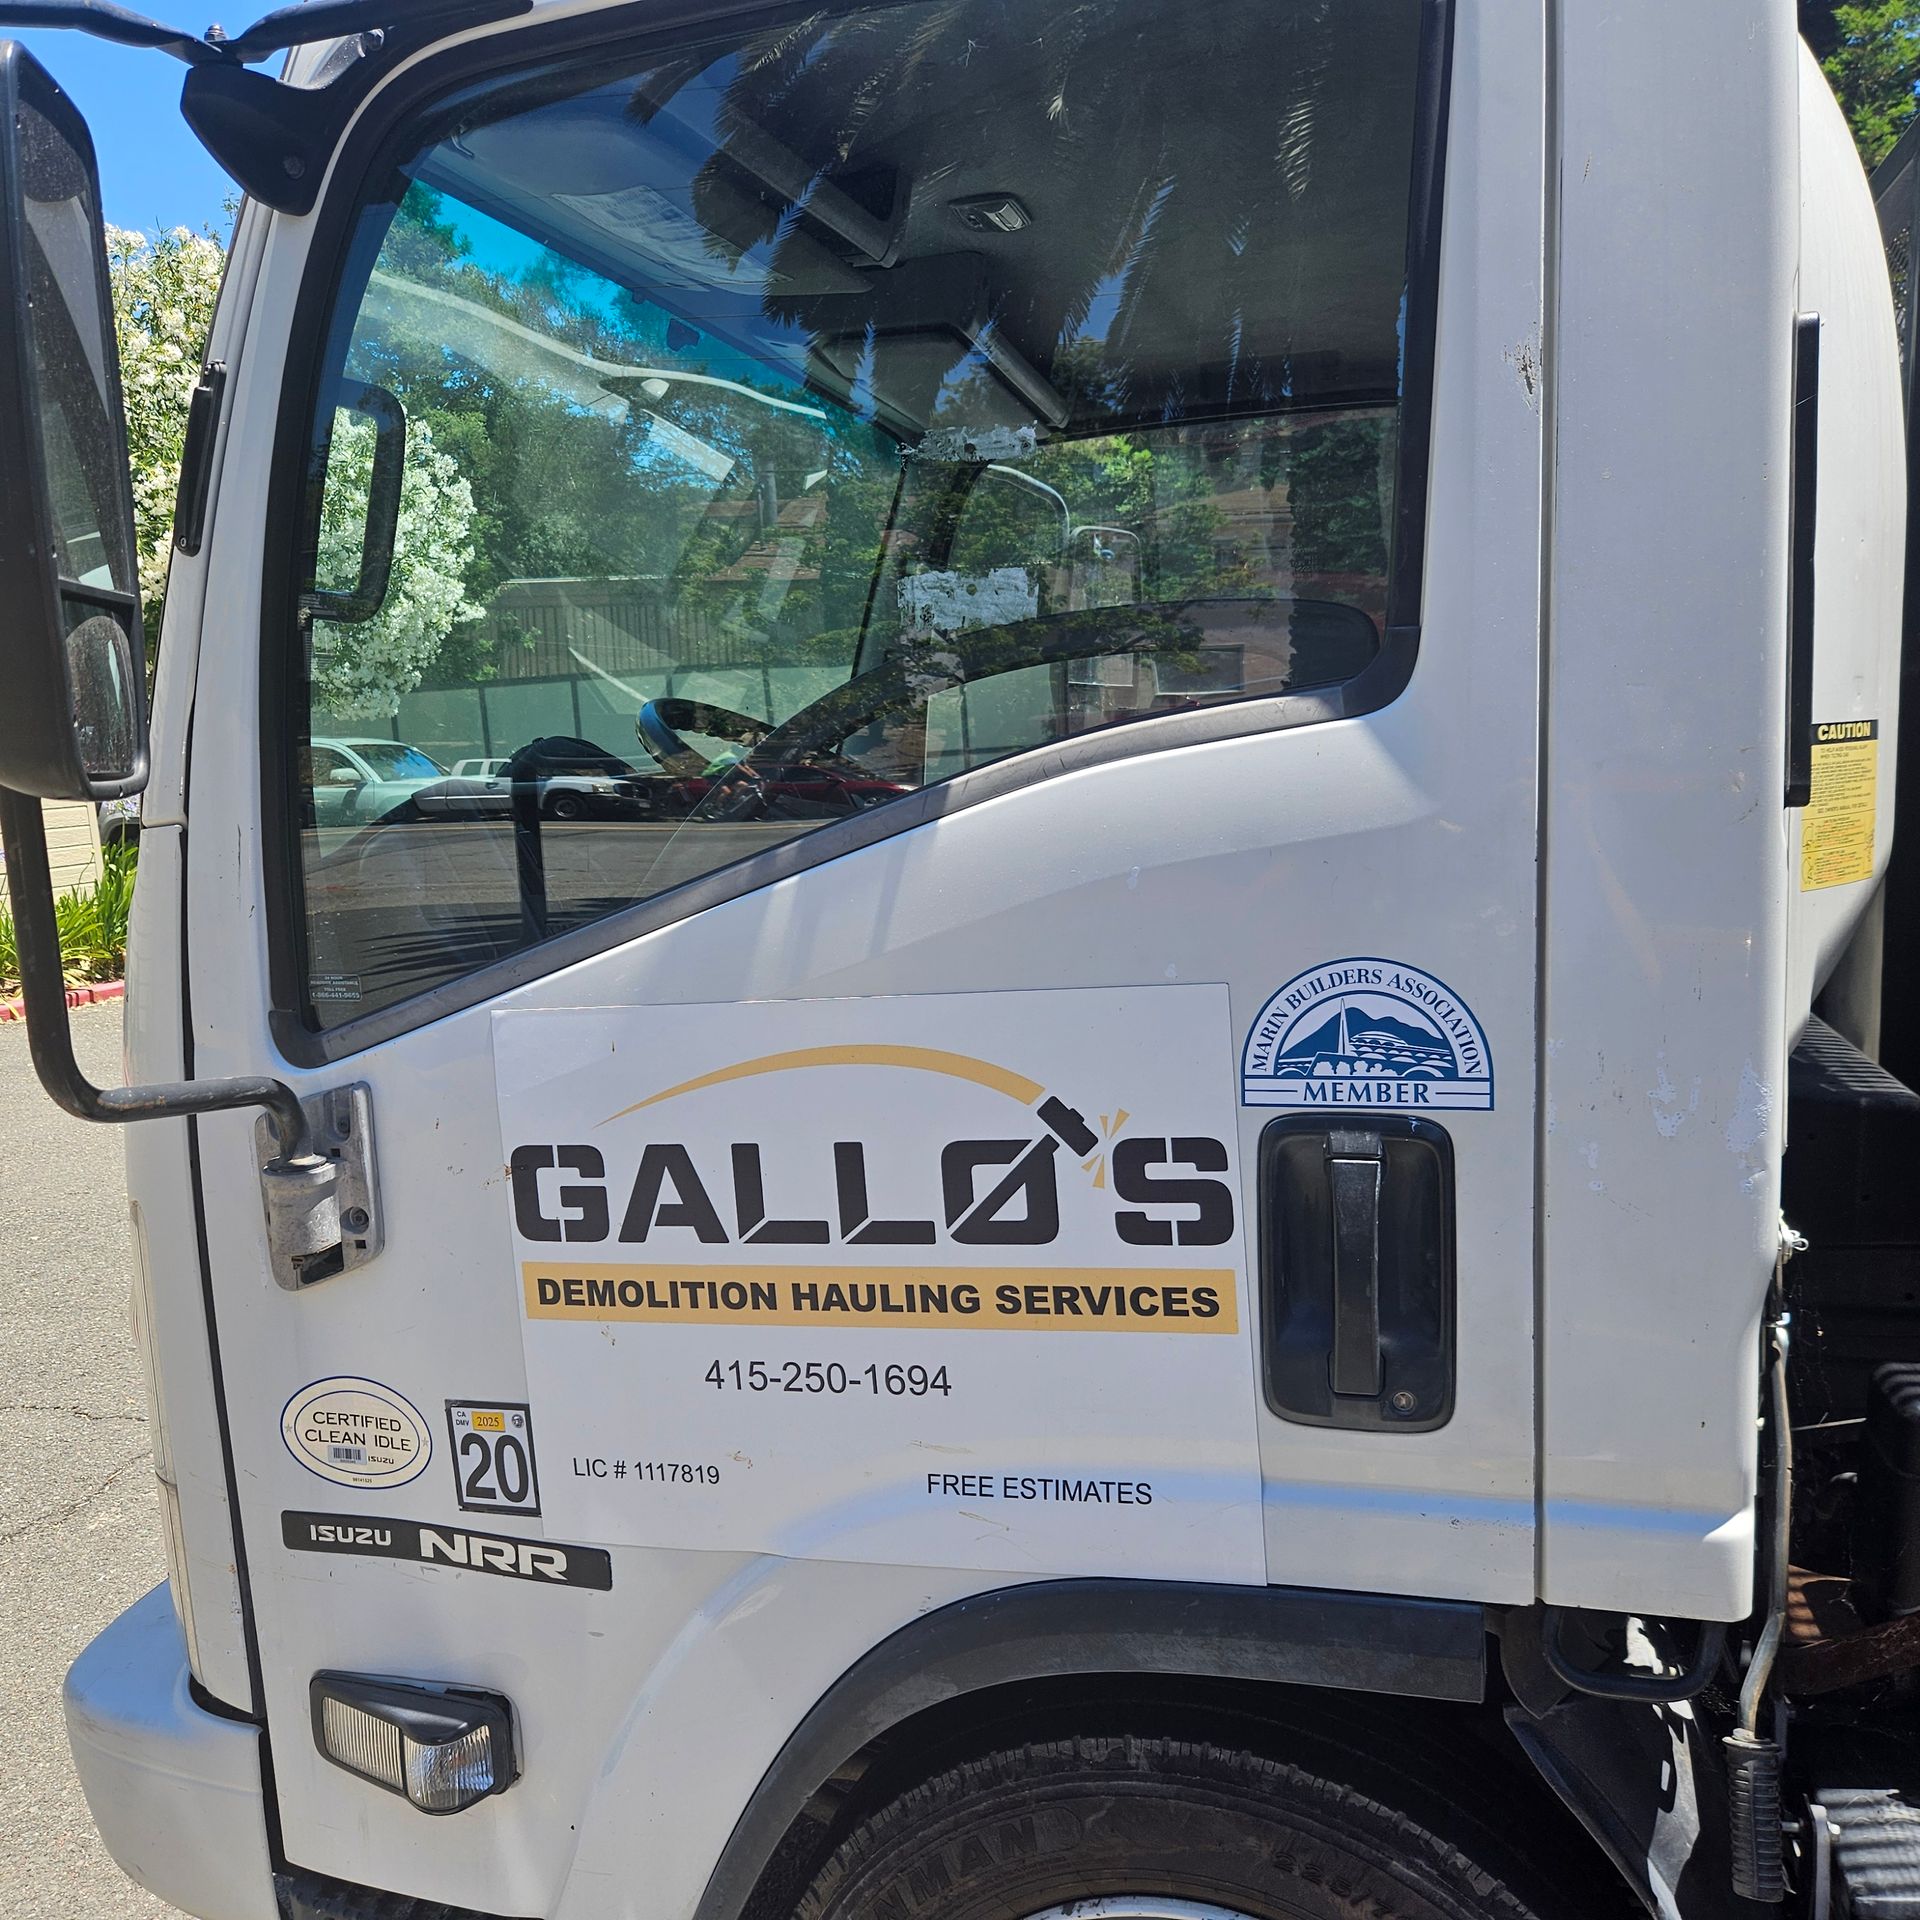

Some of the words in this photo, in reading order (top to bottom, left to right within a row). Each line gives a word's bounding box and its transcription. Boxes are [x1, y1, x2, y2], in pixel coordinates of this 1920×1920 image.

[1817, 721, 1871, 741] CAUTION
[1252, 1006, 1290, 1072] MARIN
[1285, 968, 1383, 1011] BUILDERS
[1387, 973, 1482, 1075] ASSOCIATION
[1303, 1082, 1429, 1104] MEMBER
[511, 1098, 1235, 1247] GALLO'S
[536, 1278, 778, 1311] DEMOLITION
[791, 1281, 981, 1315] HAULING
[995, 1285, 1221, 1319] SERVICES
[704, 1359, 952, 1397] 415-250-1694
[312, 1411, 402, 1433] CERTIFIED
[476, 1416, 500, 1427] 2025
[305, 1429, 366, 1446] CLEAN
[374, 1435, 412, 1452] IDLE
[368, 1455, 394, 1465] ISUZU
[460, 1432, 529, 1503] 20
[573, 1457, 608, 1478] LIC
[613, 1460, 627, 1479] #
[634, 1461, 720, 1485] 1117819
[927, 1473, 994, 1498] FREE
[1003, 1477, 1153, 1505] ESTIMATES
[310, 1524, 392, 1546] ISUZU
[419, 1528, 568, 1580] NRR
